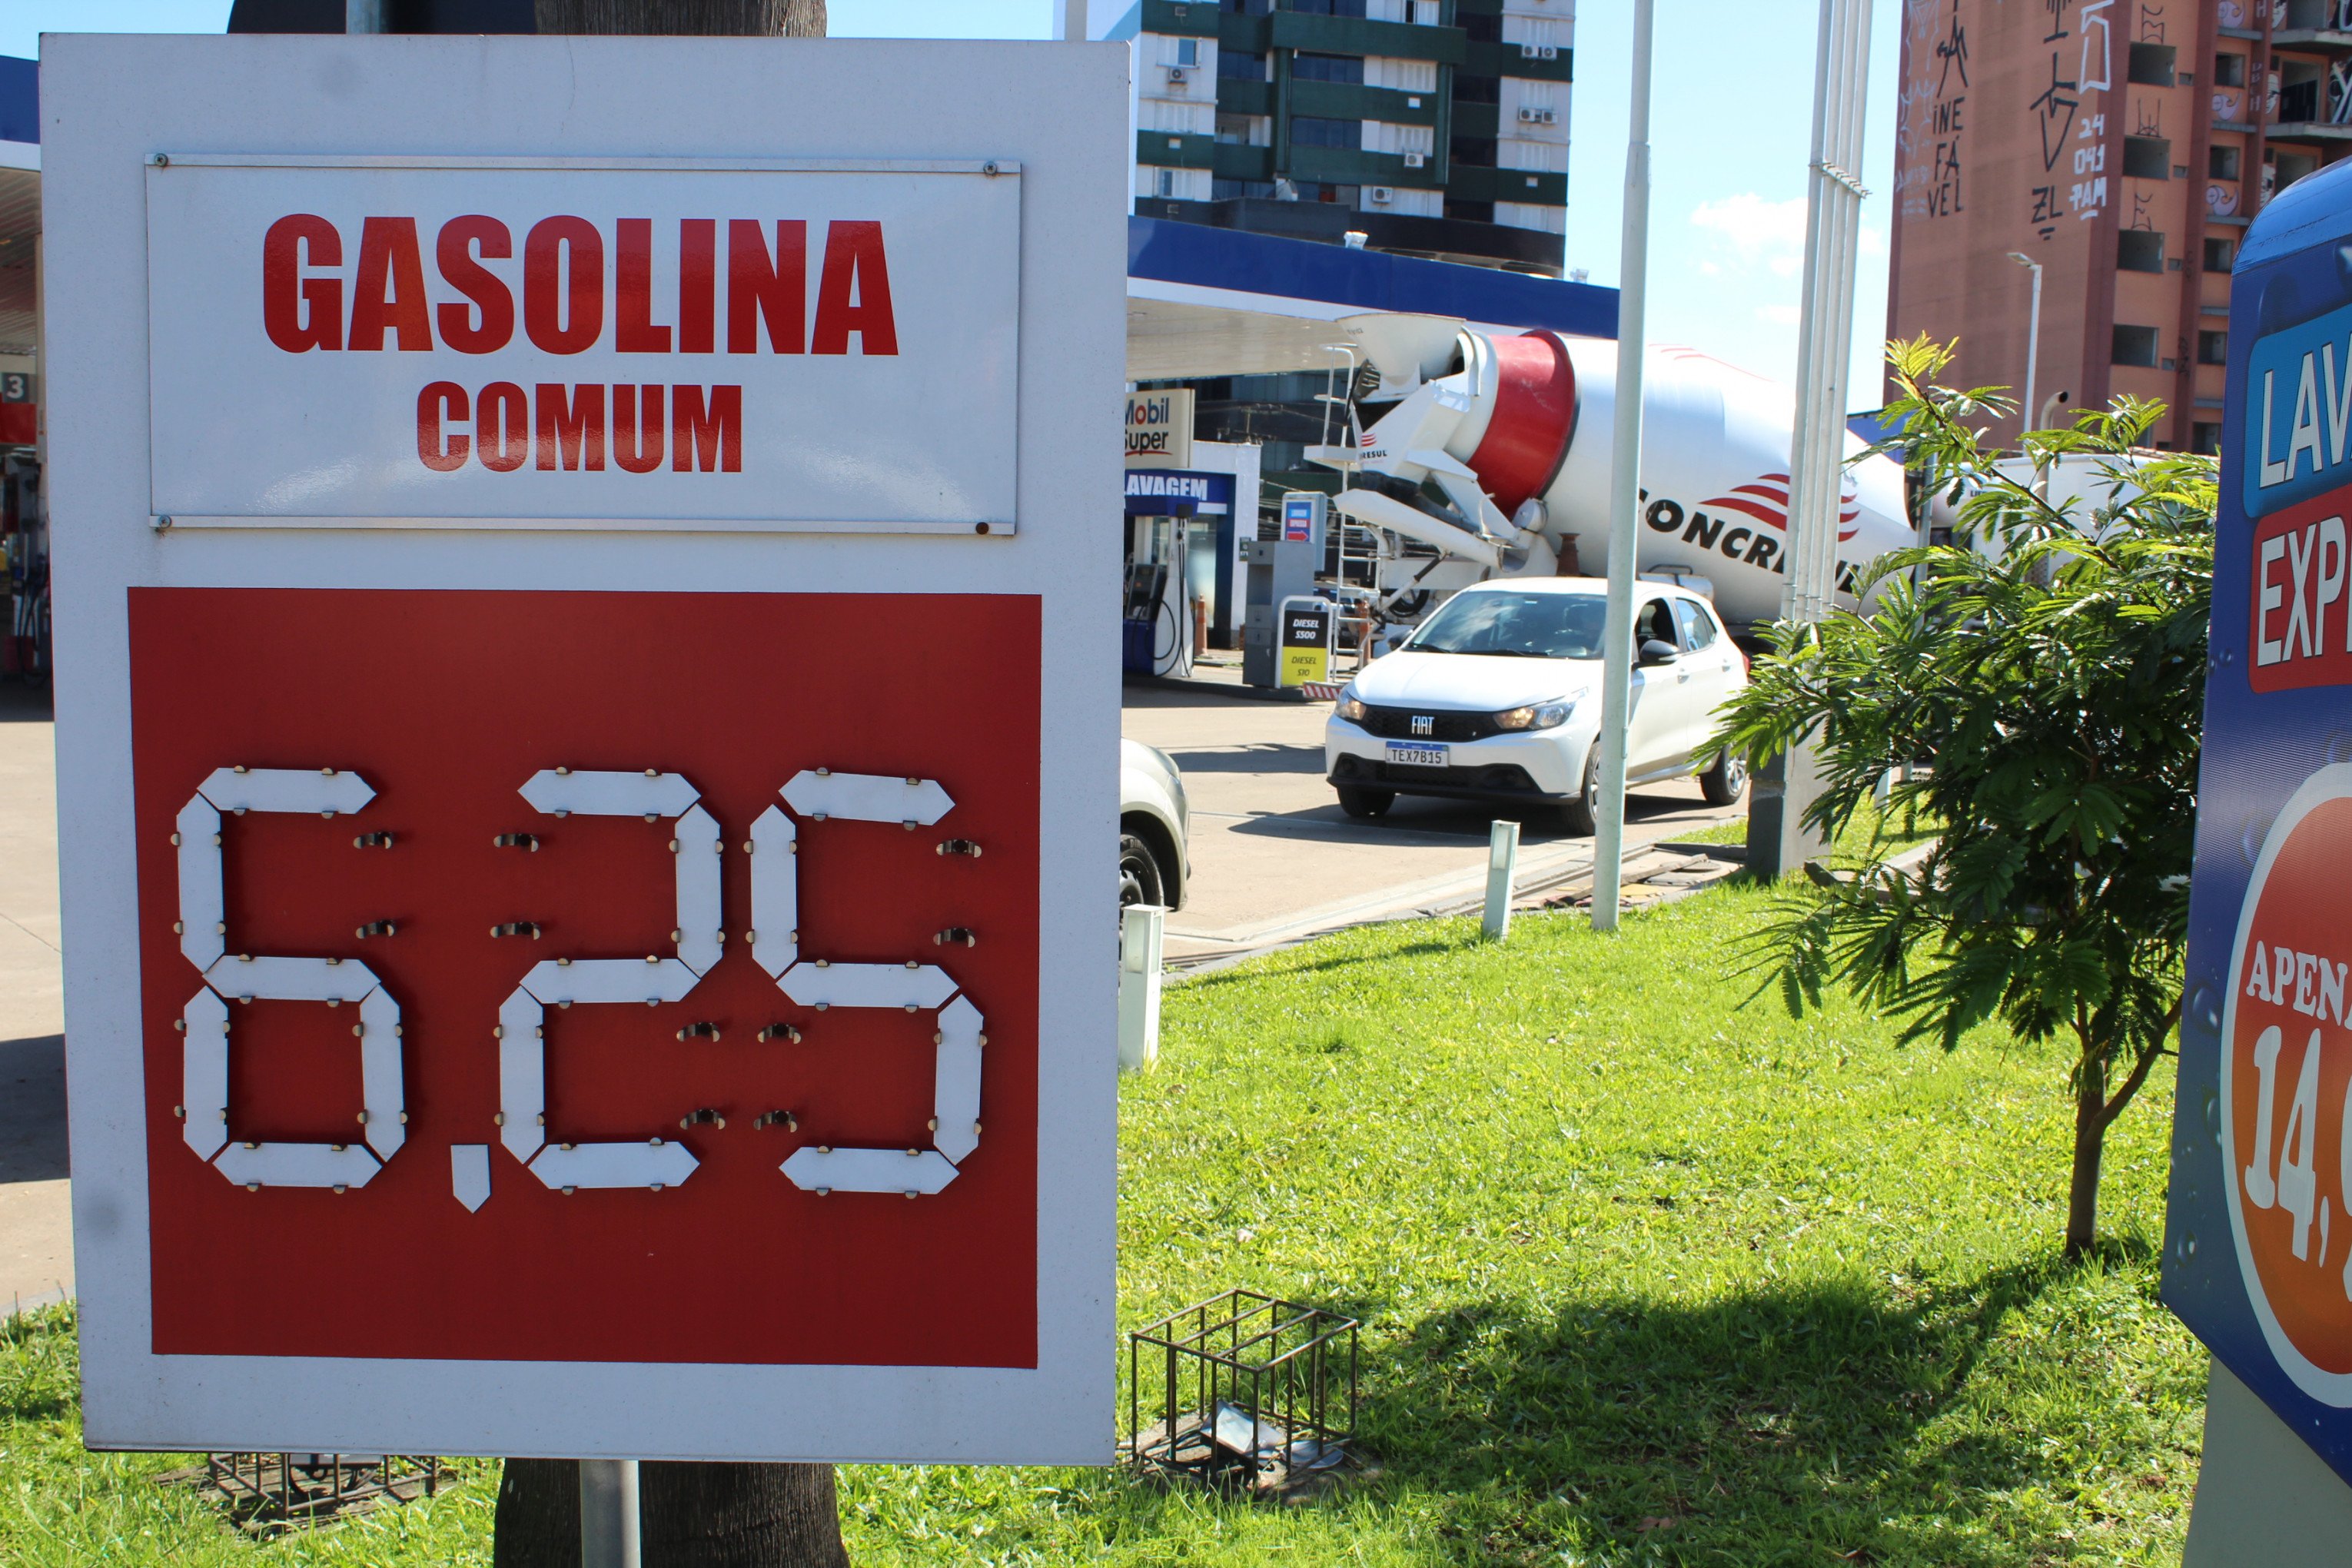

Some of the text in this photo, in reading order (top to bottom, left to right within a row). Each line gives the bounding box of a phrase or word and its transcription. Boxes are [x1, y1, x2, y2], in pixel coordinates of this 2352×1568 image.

[2078, 114, 2105, 139] 24
[263, 213, 899, 356] GASOLINA
[7, 374, 24, 399] 3
[2259, 332, 2352, 490] LAV
[417, 380, 742, 473] COMUM
[1125, 473, 1208, 501] AVAGEM
[2257, 516, 2352, 666] EXP
[1293, 619, 1319, 628] DIESEL
[1295, 631, 1317, 639] S500
[1291, 656, 1317, 665] DIESEL
[1411, 715, 1435, 735] FIAT
[1391, 749, 1442, 764] TEX7B15
[174, 766, 985, 1214] 6,25
[2246, 939, 2352, 1031] APEN
[2244, 1025, 2352, 1304] 14,
